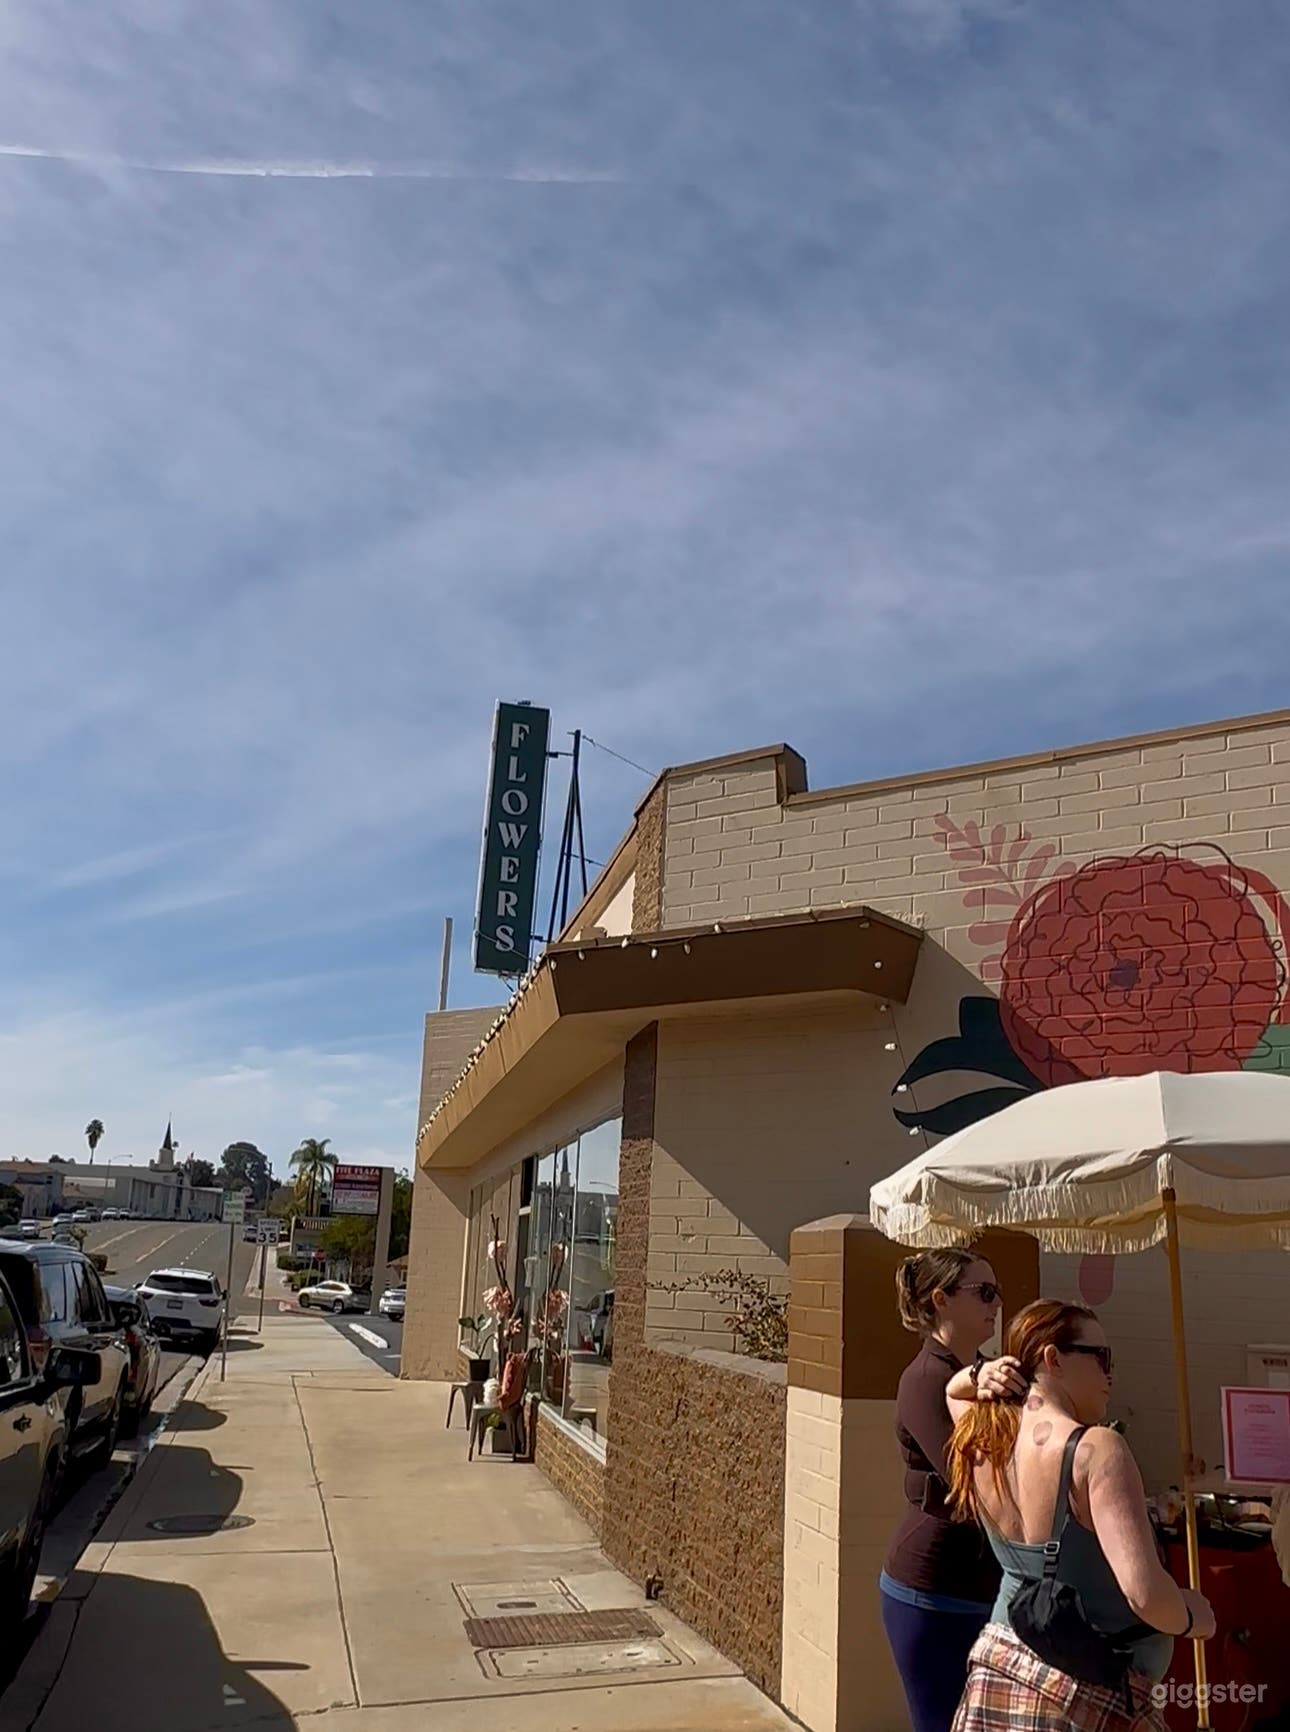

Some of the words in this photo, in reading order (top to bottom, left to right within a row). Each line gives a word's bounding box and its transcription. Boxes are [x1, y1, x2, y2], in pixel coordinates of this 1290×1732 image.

[495, 722, 530, 953] FLOWERS
[354, 1167, 380, 1176] PLAZA
[258, 1232, 277, 1243] 35
